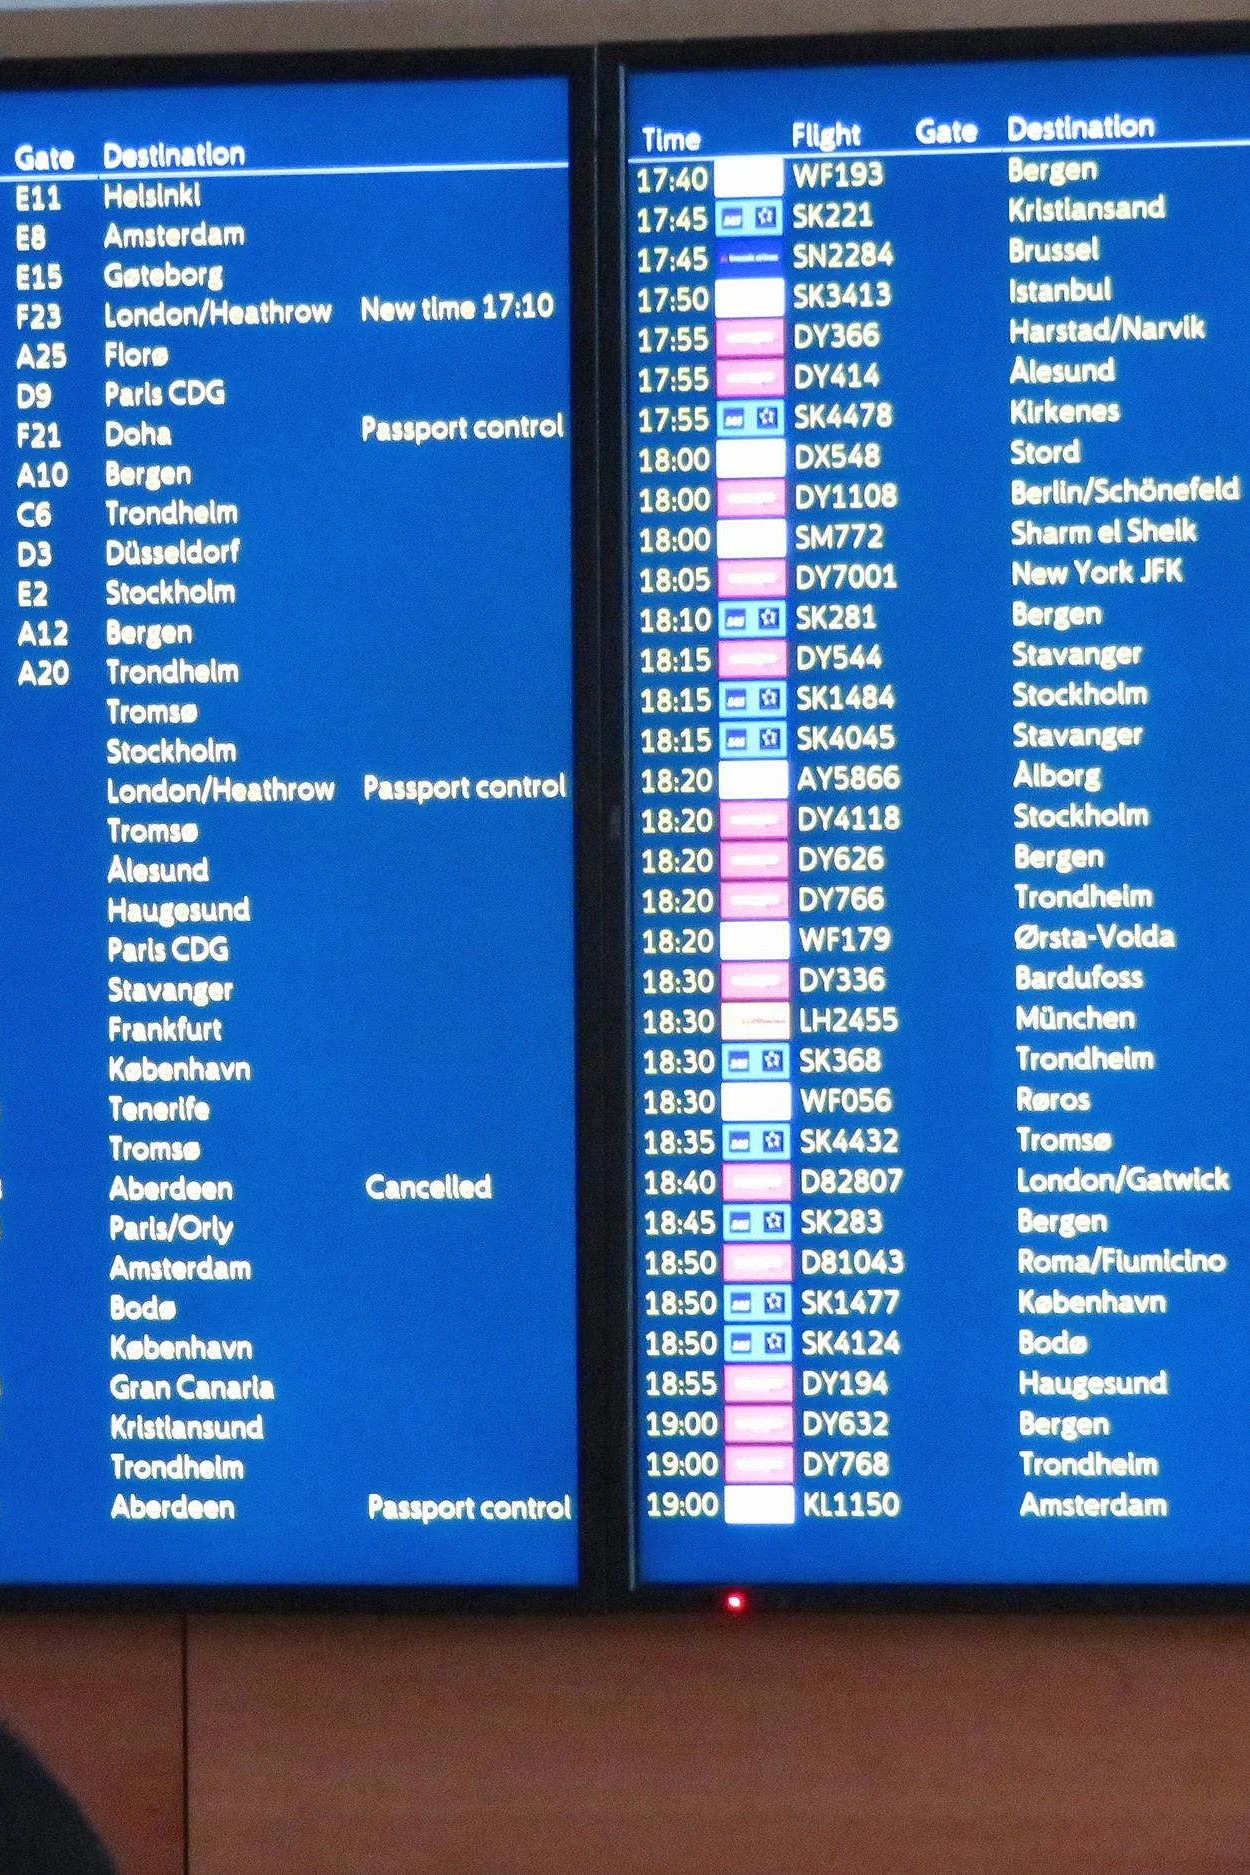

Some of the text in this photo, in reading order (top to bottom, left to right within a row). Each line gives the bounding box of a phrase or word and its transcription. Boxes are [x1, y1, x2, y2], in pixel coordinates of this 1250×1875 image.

[641, 113, 1156, 152] Time Flight Gate Destination
[14, 144, 75, 172] Gate
[103, 140, 246, 170] Destination
[15, 184, 62, 212] E11
[104, 181, 201, 209] Helsinki
[637, 193, 1167, 233] 17:45 SK221 Kristiansand
[16, 303, 62, 330] F23
[104, 297, 333, 329] London/Heathrow
[360, 295, 416, 322] New
[421, 295, 477, 321] time
[482, 291, 555, 320] 17:10
[637, 313, 1206, 354] 17:55 DY366 Harstad/Narvik
[16, 421, 62, 449] F21
[105, 420, 173, 448] Doha
[361, 415, 469, 446] Passport
[473, 411, 565, 440] control
[639, 475, 1241, 514] 18:00 DY1108 Berlin/Schönefeld
[639, 516, 1198, 553] 18:00 SM772 Sharm el Sheik
[17, 580, 48, 607] E2
[105, 577, 236, 606] Stockholm
[640, 679, 1149, 714] 18:15 SK1484 Stockholm
[107, 774, 336, 805] London/Heathrow
[363, 774, 471, 805] Passport
[475, 772, 567, 800] control
[641, 801, 1150, 834] 18:20 DY4118 Stockholm
[107, 895, 251, 929] Haugesund
[642, 922, 1177, 955] 18:20 WF179 Ørsta-Volda
[643, 1004, 1136, 1035] 18:30 LH2455 München
[643, 1085, 1091, 1115] 18:30 WF056 Røros
[108, 1174, 234, 1202] Aberdeen
[365, 1173, 493, 1200] Cancelled
[644, 1164, 1231, 1196] 18:40 D82807 London/Gatwick
[645, 1245, 1228, 1276] 18:50 D81043 Roma/Fiumicino
[109, 1373, 172, 1401] Gran
[175, 1373, 275, 1400] Canaria
[645, 1369, 1169, 1401] 18:55 DY194 Haugesund
[110, 1493, 236, 1520] Aberdeen
[368, 1493, 476, 1525] Passport
[479, 1494, 572, 1520] control
[646, 1491, 1168, 1518] 19:00 KL1150 Amsterdam
